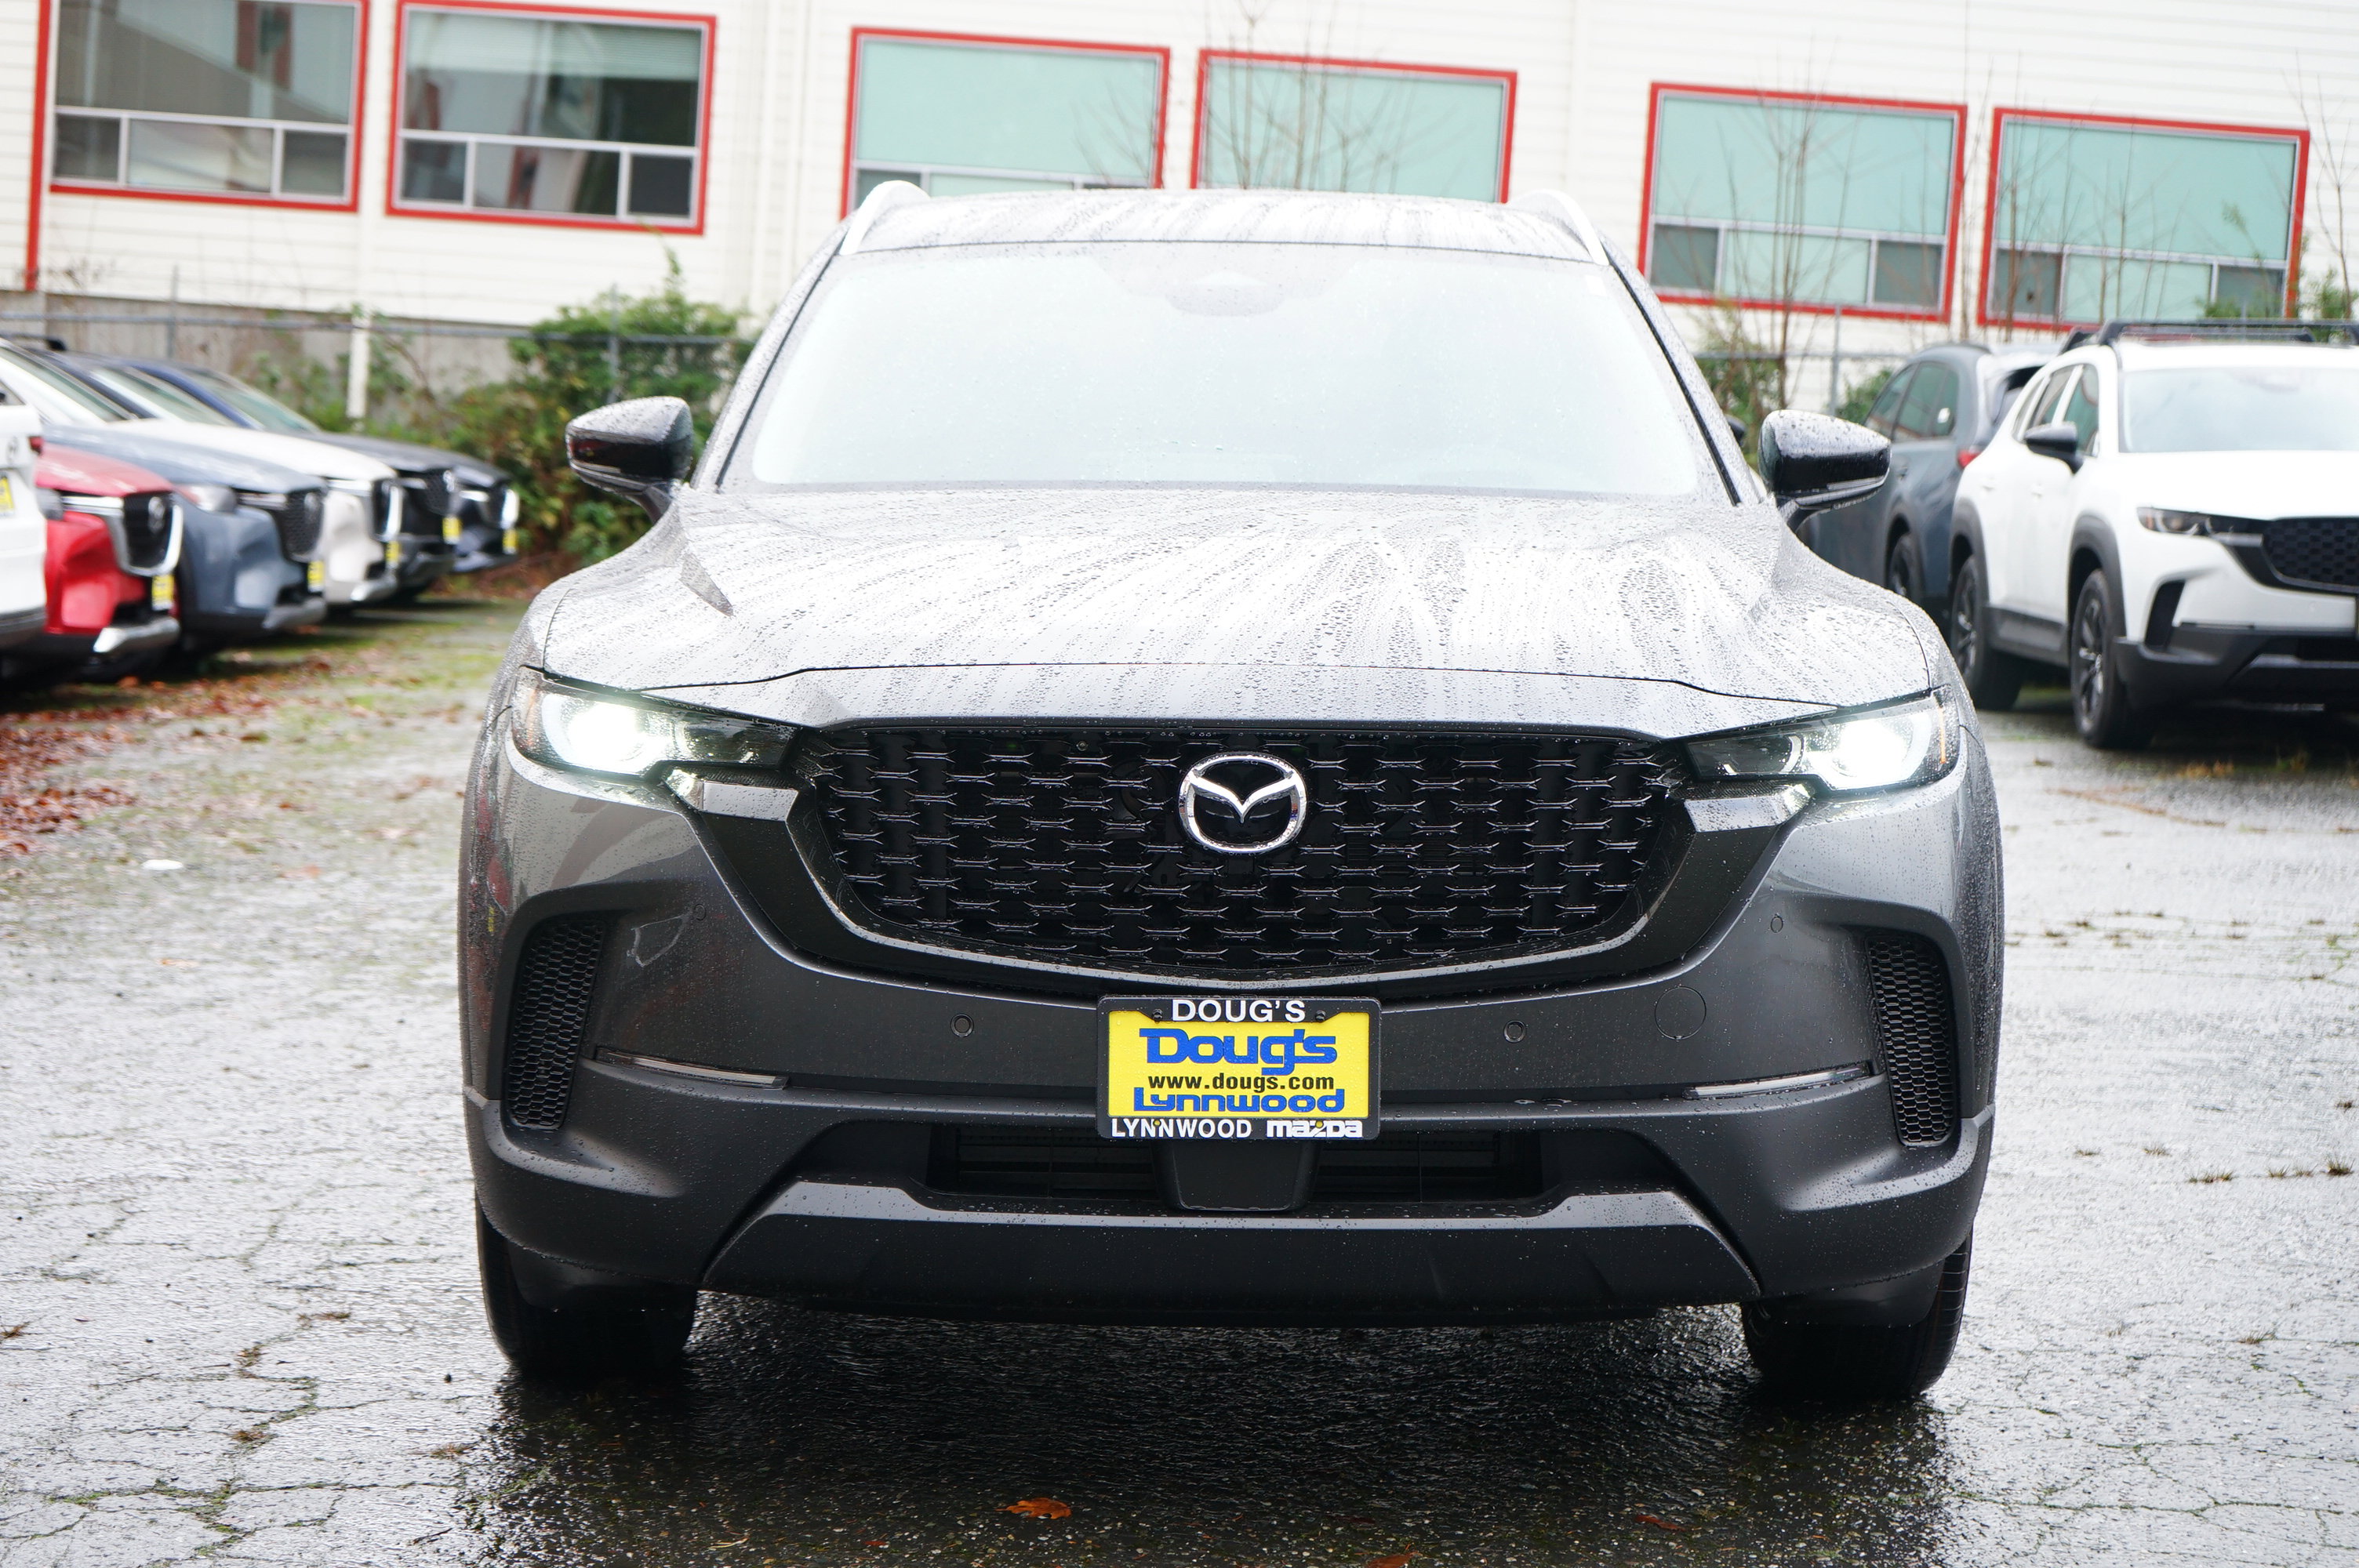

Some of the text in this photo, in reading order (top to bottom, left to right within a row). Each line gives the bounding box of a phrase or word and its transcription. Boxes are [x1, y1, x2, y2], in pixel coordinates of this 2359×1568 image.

[1172, 999, 1306, 1022] DOUG'S
[1139, 1028, 1338, 1076] Doug's
[1148, 1072, 1335, 1093] www.dougs.com
[1133, 1087, 1346, 1113] Lynnwood
[1111, 1118, 1252, 1138] LYNNWOOD
